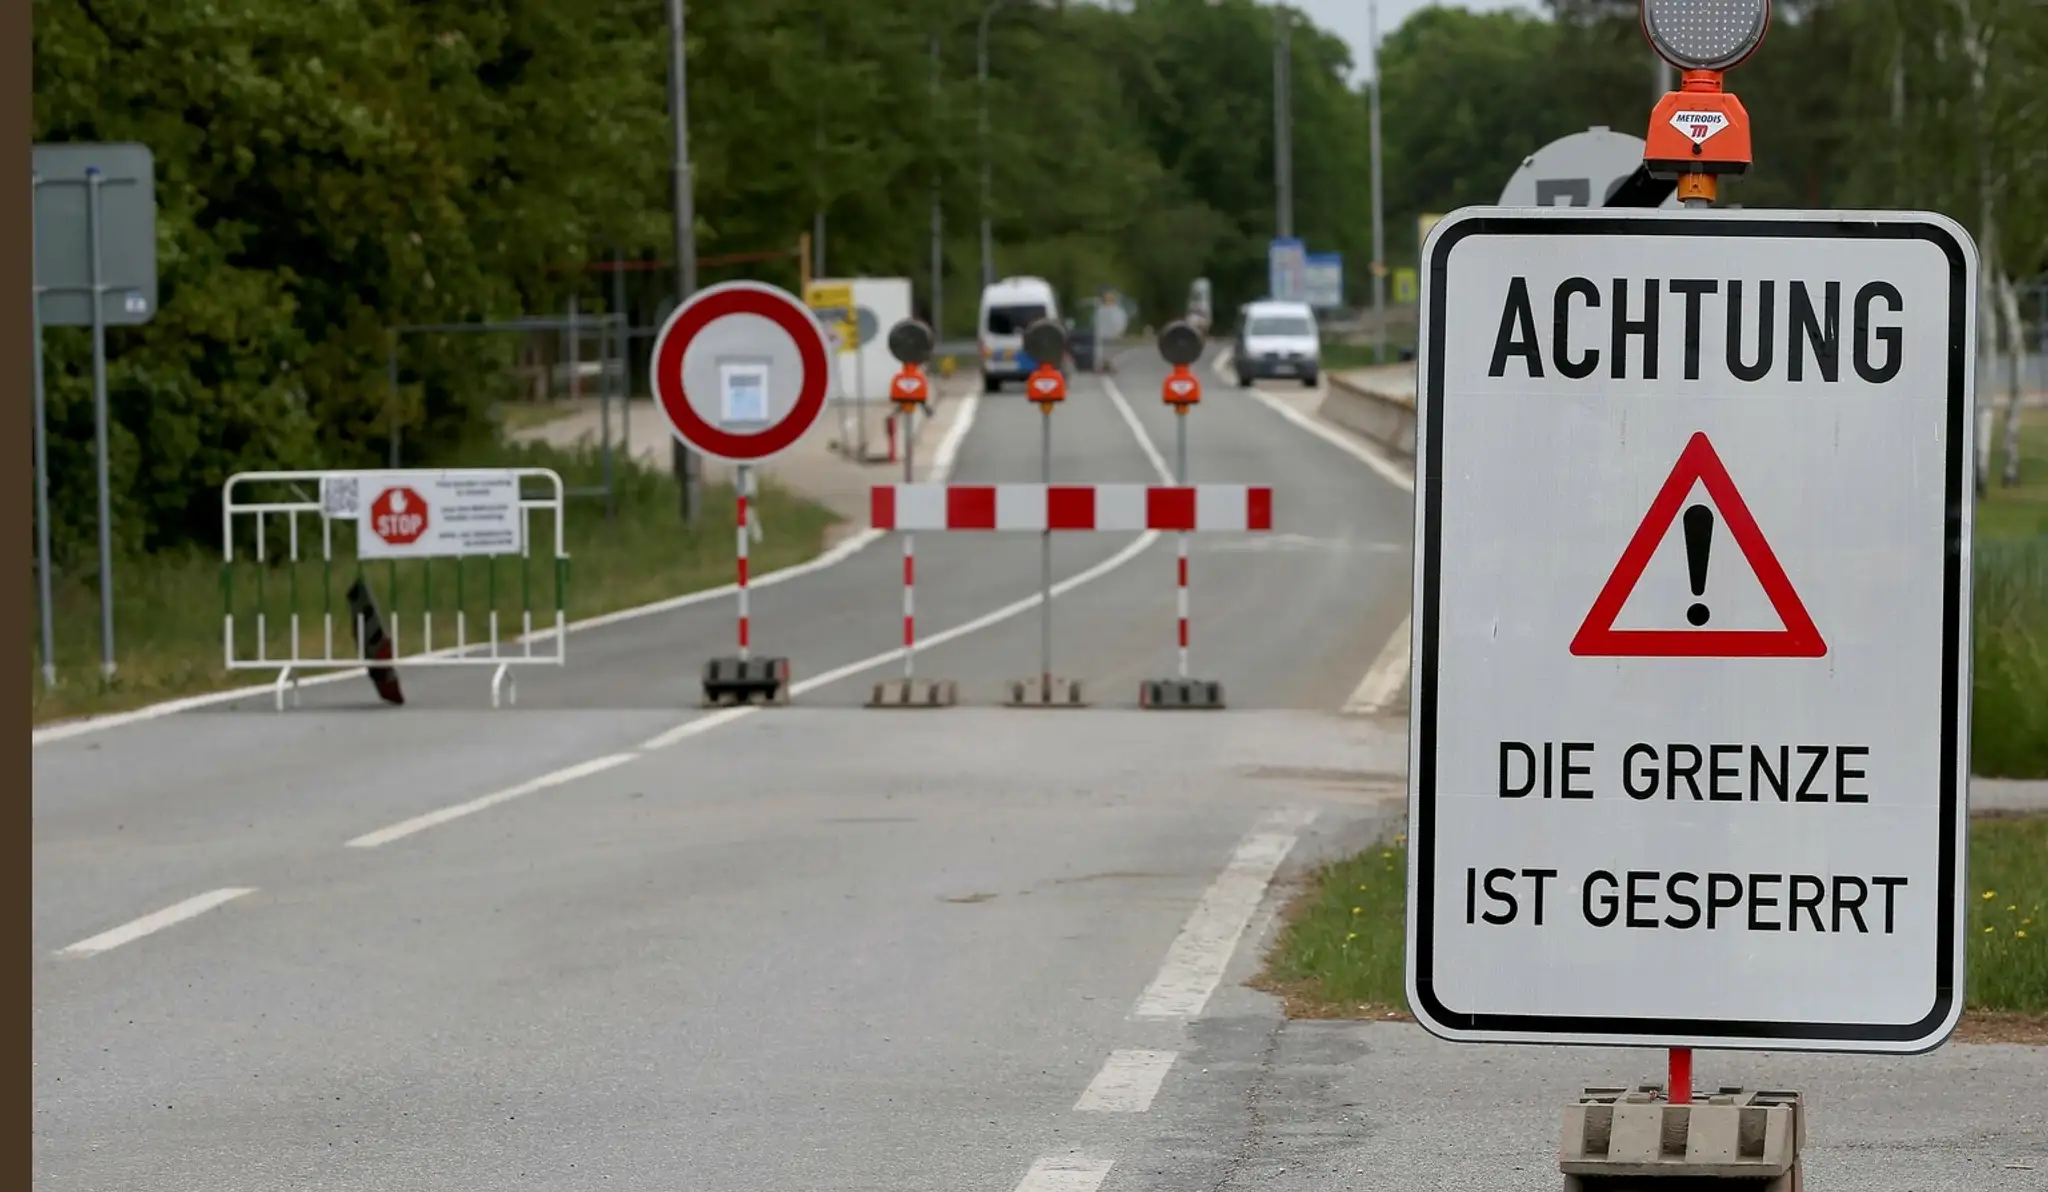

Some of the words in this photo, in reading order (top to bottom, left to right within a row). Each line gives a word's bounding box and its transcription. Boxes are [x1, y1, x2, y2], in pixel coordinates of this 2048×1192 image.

[1676, 114, 1722, 124] METRODIS
[1488, 277, 1903, 383] ACHTUNG
[378, 514, 422, 536] STOP
[1499, 742, 1594, 799] DIE
[1623, 743, 1869, 803] GRENZE
[1467, 868, 1557, 925] IST
[1583, 870, 1908, 933] GESPERRT
